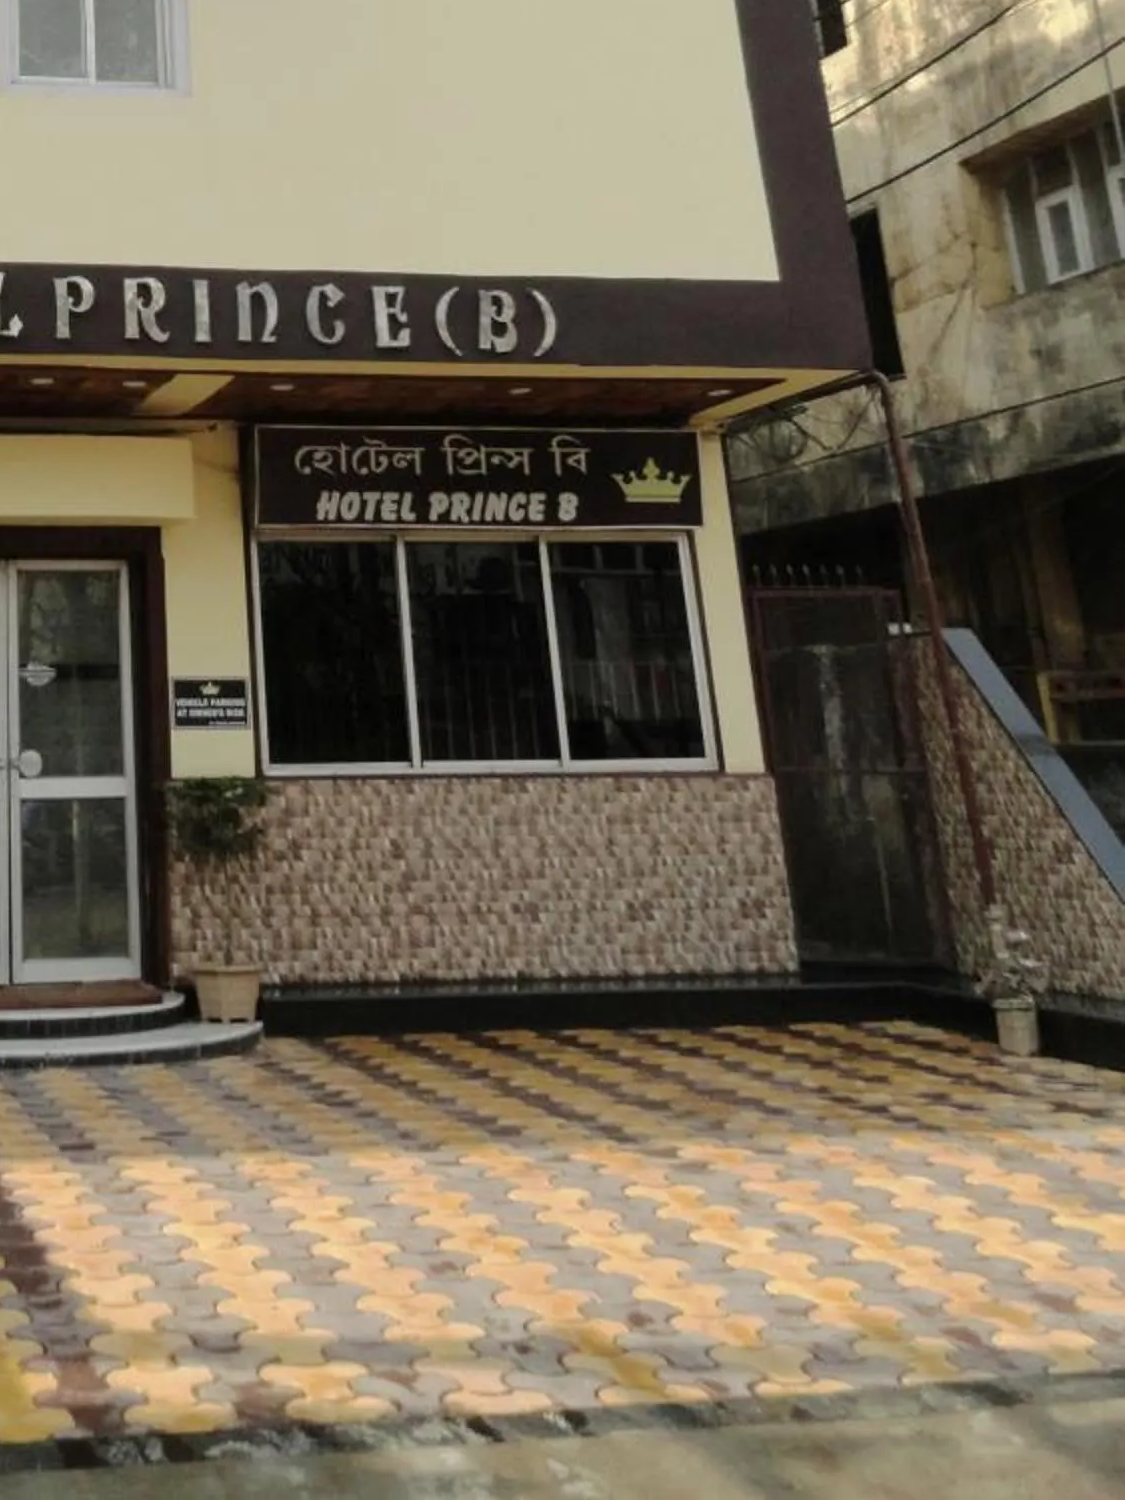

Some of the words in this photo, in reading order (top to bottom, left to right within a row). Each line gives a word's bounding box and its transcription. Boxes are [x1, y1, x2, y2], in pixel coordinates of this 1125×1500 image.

[293, 436, 426, 476] হোটেল
[441, 434, 534, 476] প্রিন্স
[549, 435, 591, 476] বি
[316, 491, 418, 522] HOTEL
[428, 492, 546, 524] PRINCE
[557, 492, 580, 523] B
